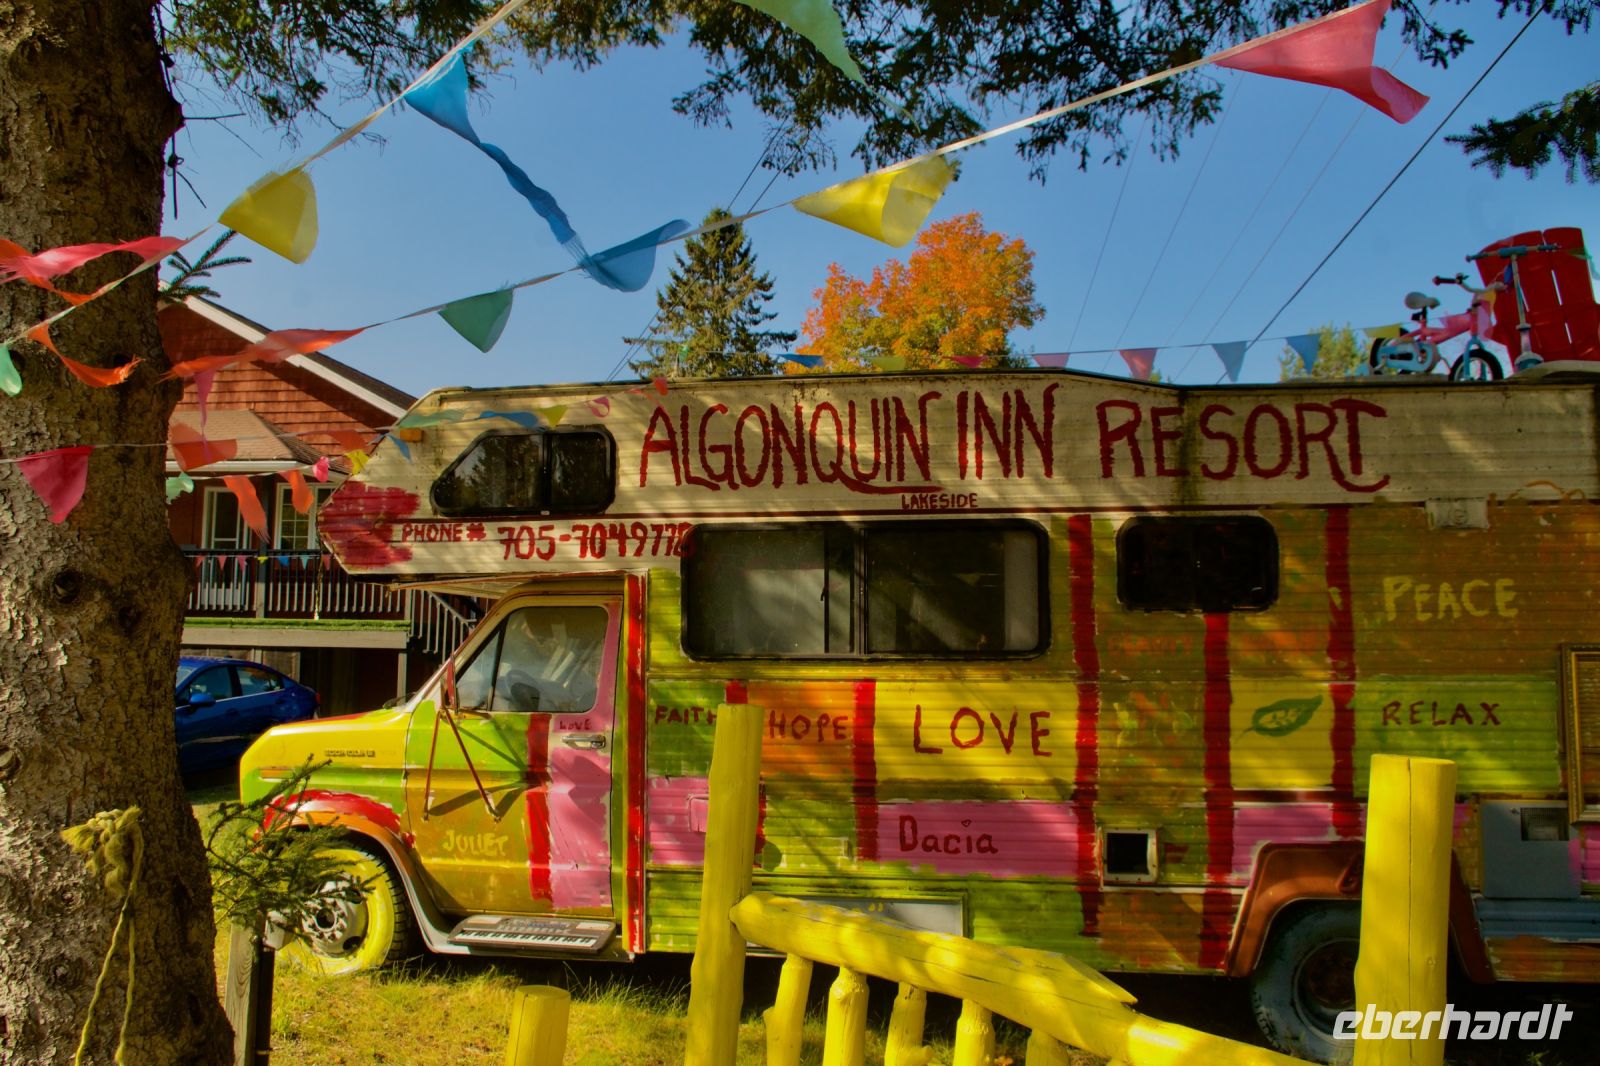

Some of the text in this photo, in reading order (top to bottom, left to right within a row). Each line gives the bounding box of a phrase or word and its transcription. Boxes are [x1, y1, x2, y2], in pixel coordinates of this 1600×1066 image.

[639, 382, 1390, 495] ALGONQUIN INN RESORT
[901, 492, 979, 510] LAKESIDE
[1381, 575, 1519, 622] PEACE
[768, 709, 850, 743] HOPE
[914, 703, 1052, 757] LOVE
[1382, 700, 1501, 727] RELAX
[899, 814, 998, 855] Dacia
